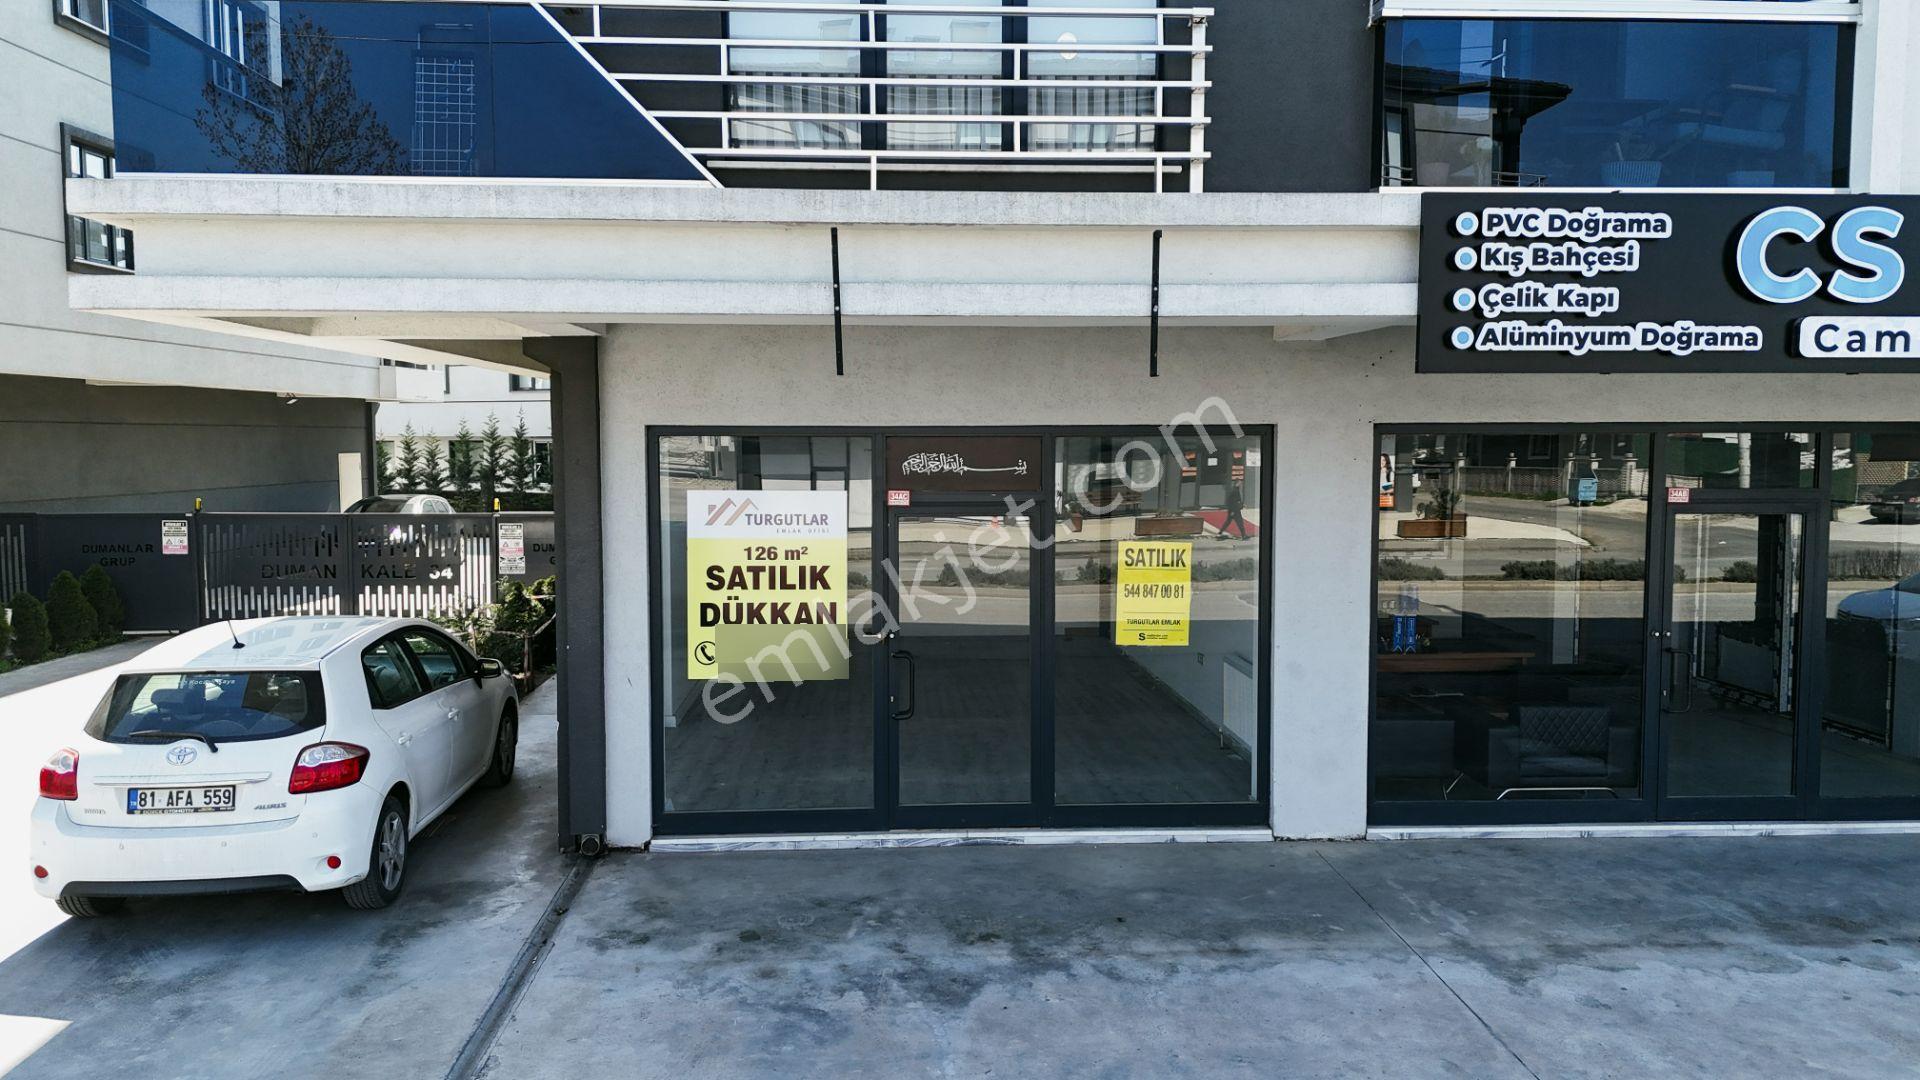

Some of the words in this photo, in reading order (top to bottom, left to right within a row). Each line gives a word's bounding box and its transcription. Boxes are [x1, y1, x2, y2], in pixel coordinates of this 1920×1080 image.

[1486, 213, 1541, 233] PVC
[1547, 211, 1668, 238] Doğrama
[1484, 246, 1525, 272] Kış
[1531, 244, 1635, 272] Bahçesi
[1736, 205, 1906, 304] CS
[1482, 285, 1549, 313] Çelik
[1556, 288, 1615, 312] Kapı
[1480, 324, 1632, 350] Alüminyum
[1640, 325, 1760, 350] Doğrama
[1814, 323, 1912, 353] Cam
[744, 513, 829, 526] TURGUTLAR
[81, 543, 154, 554] DUMANLAR
[743, 546, 778, 561] 126
[784, 546, 809, 561] m²
[1124, 547, 1187, 568] SATILIK
[100, 556, 136, 567] GRUP
[261, 564, 337, 579] DUMAN
[360, 563, 417, 579] KALE
[428, 563, 454, 580] 34
[705, 564, 832, 591] SATILIK
[1124, 583, 1141, 598] 544
[1142, 583, 1159, 598] 847
[1160, 584, 1172, 599] 00
[1173, 584, 1185, 599] 81
[700, 595, 838, 628] DÜKKAN
[138, 790, 156, 808] 81
[166, 789, 194, 807] AFA
[203, 788, 232, 806] 559
